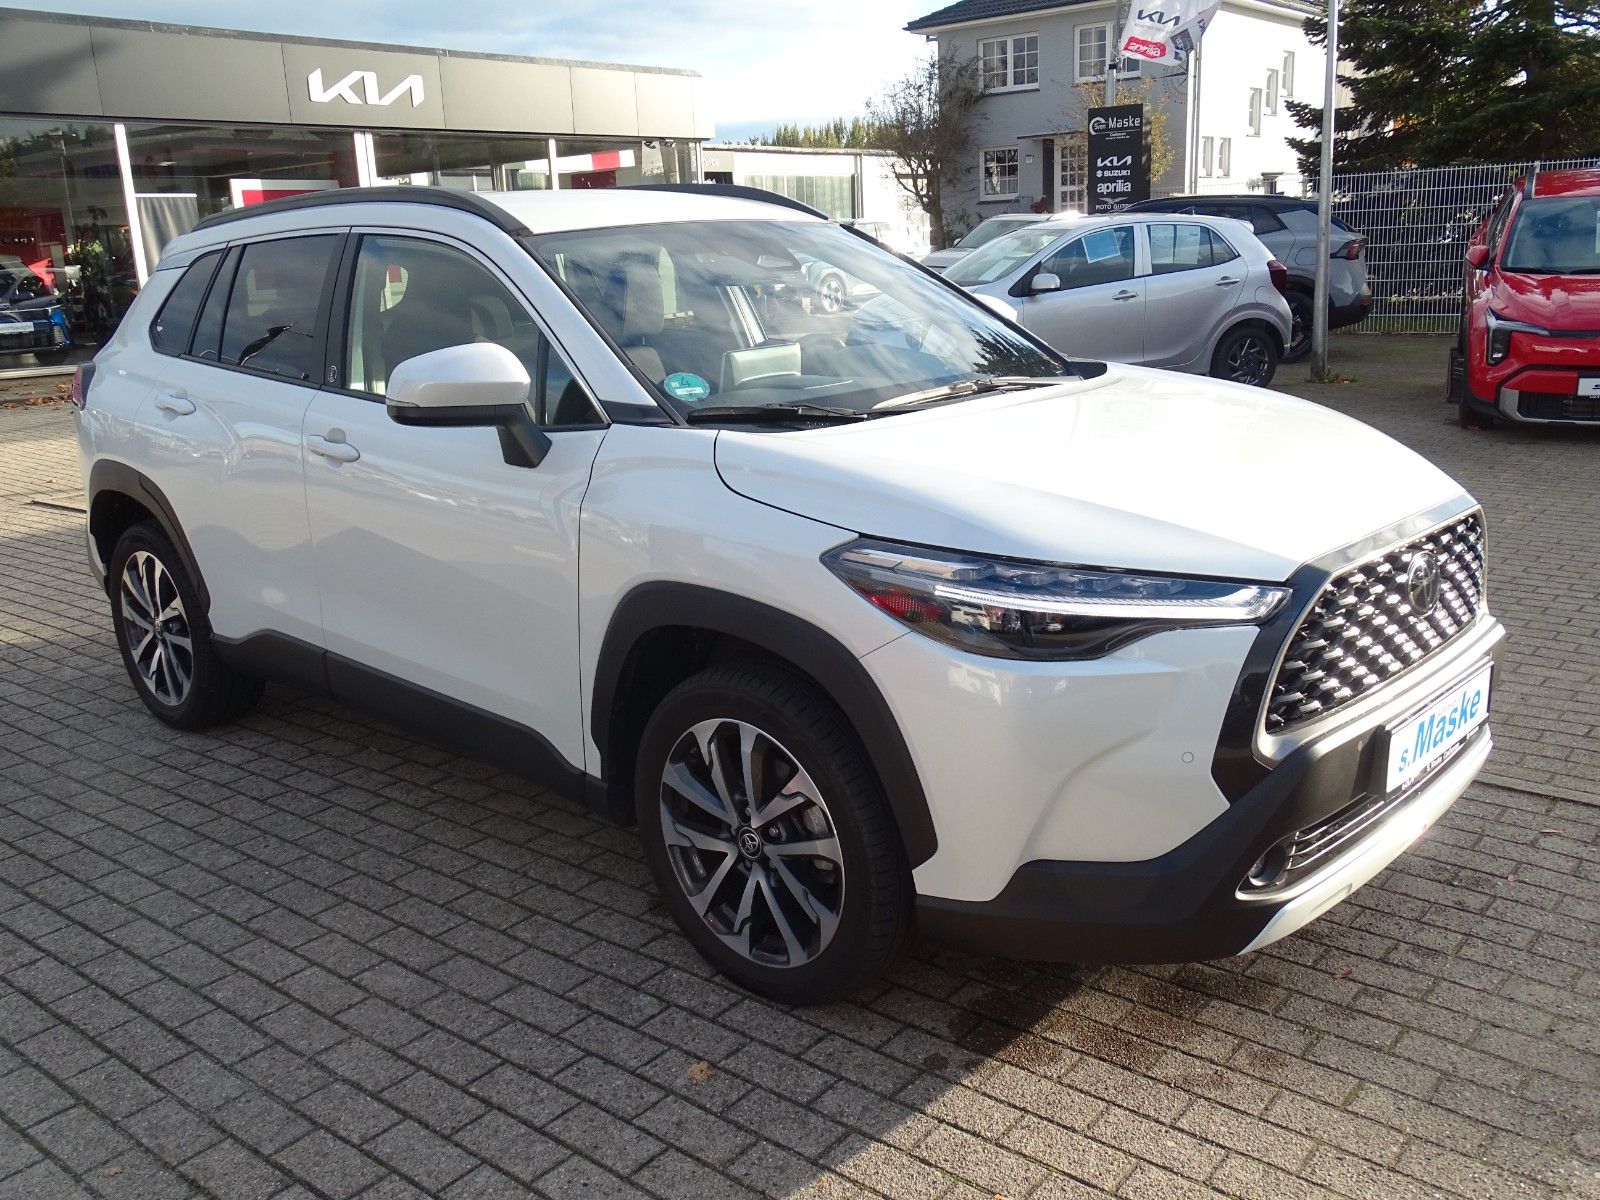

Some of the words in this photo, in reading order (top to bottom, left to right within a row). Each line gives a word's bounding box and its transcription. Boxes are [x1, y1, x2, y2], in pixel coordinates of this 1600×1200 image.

[1137, 9, 1180, 27] KIA
[1128, 42, 1161, 57] aprilia
[307, 67, 425, 108] KIA
[1108, 115, 1141, 129] Maske
[1096, 155, 1132, 167] KIA
[1104, 169, 1131, 177] SUZUKI
[1096, 180, 1131, 195] aprilia
